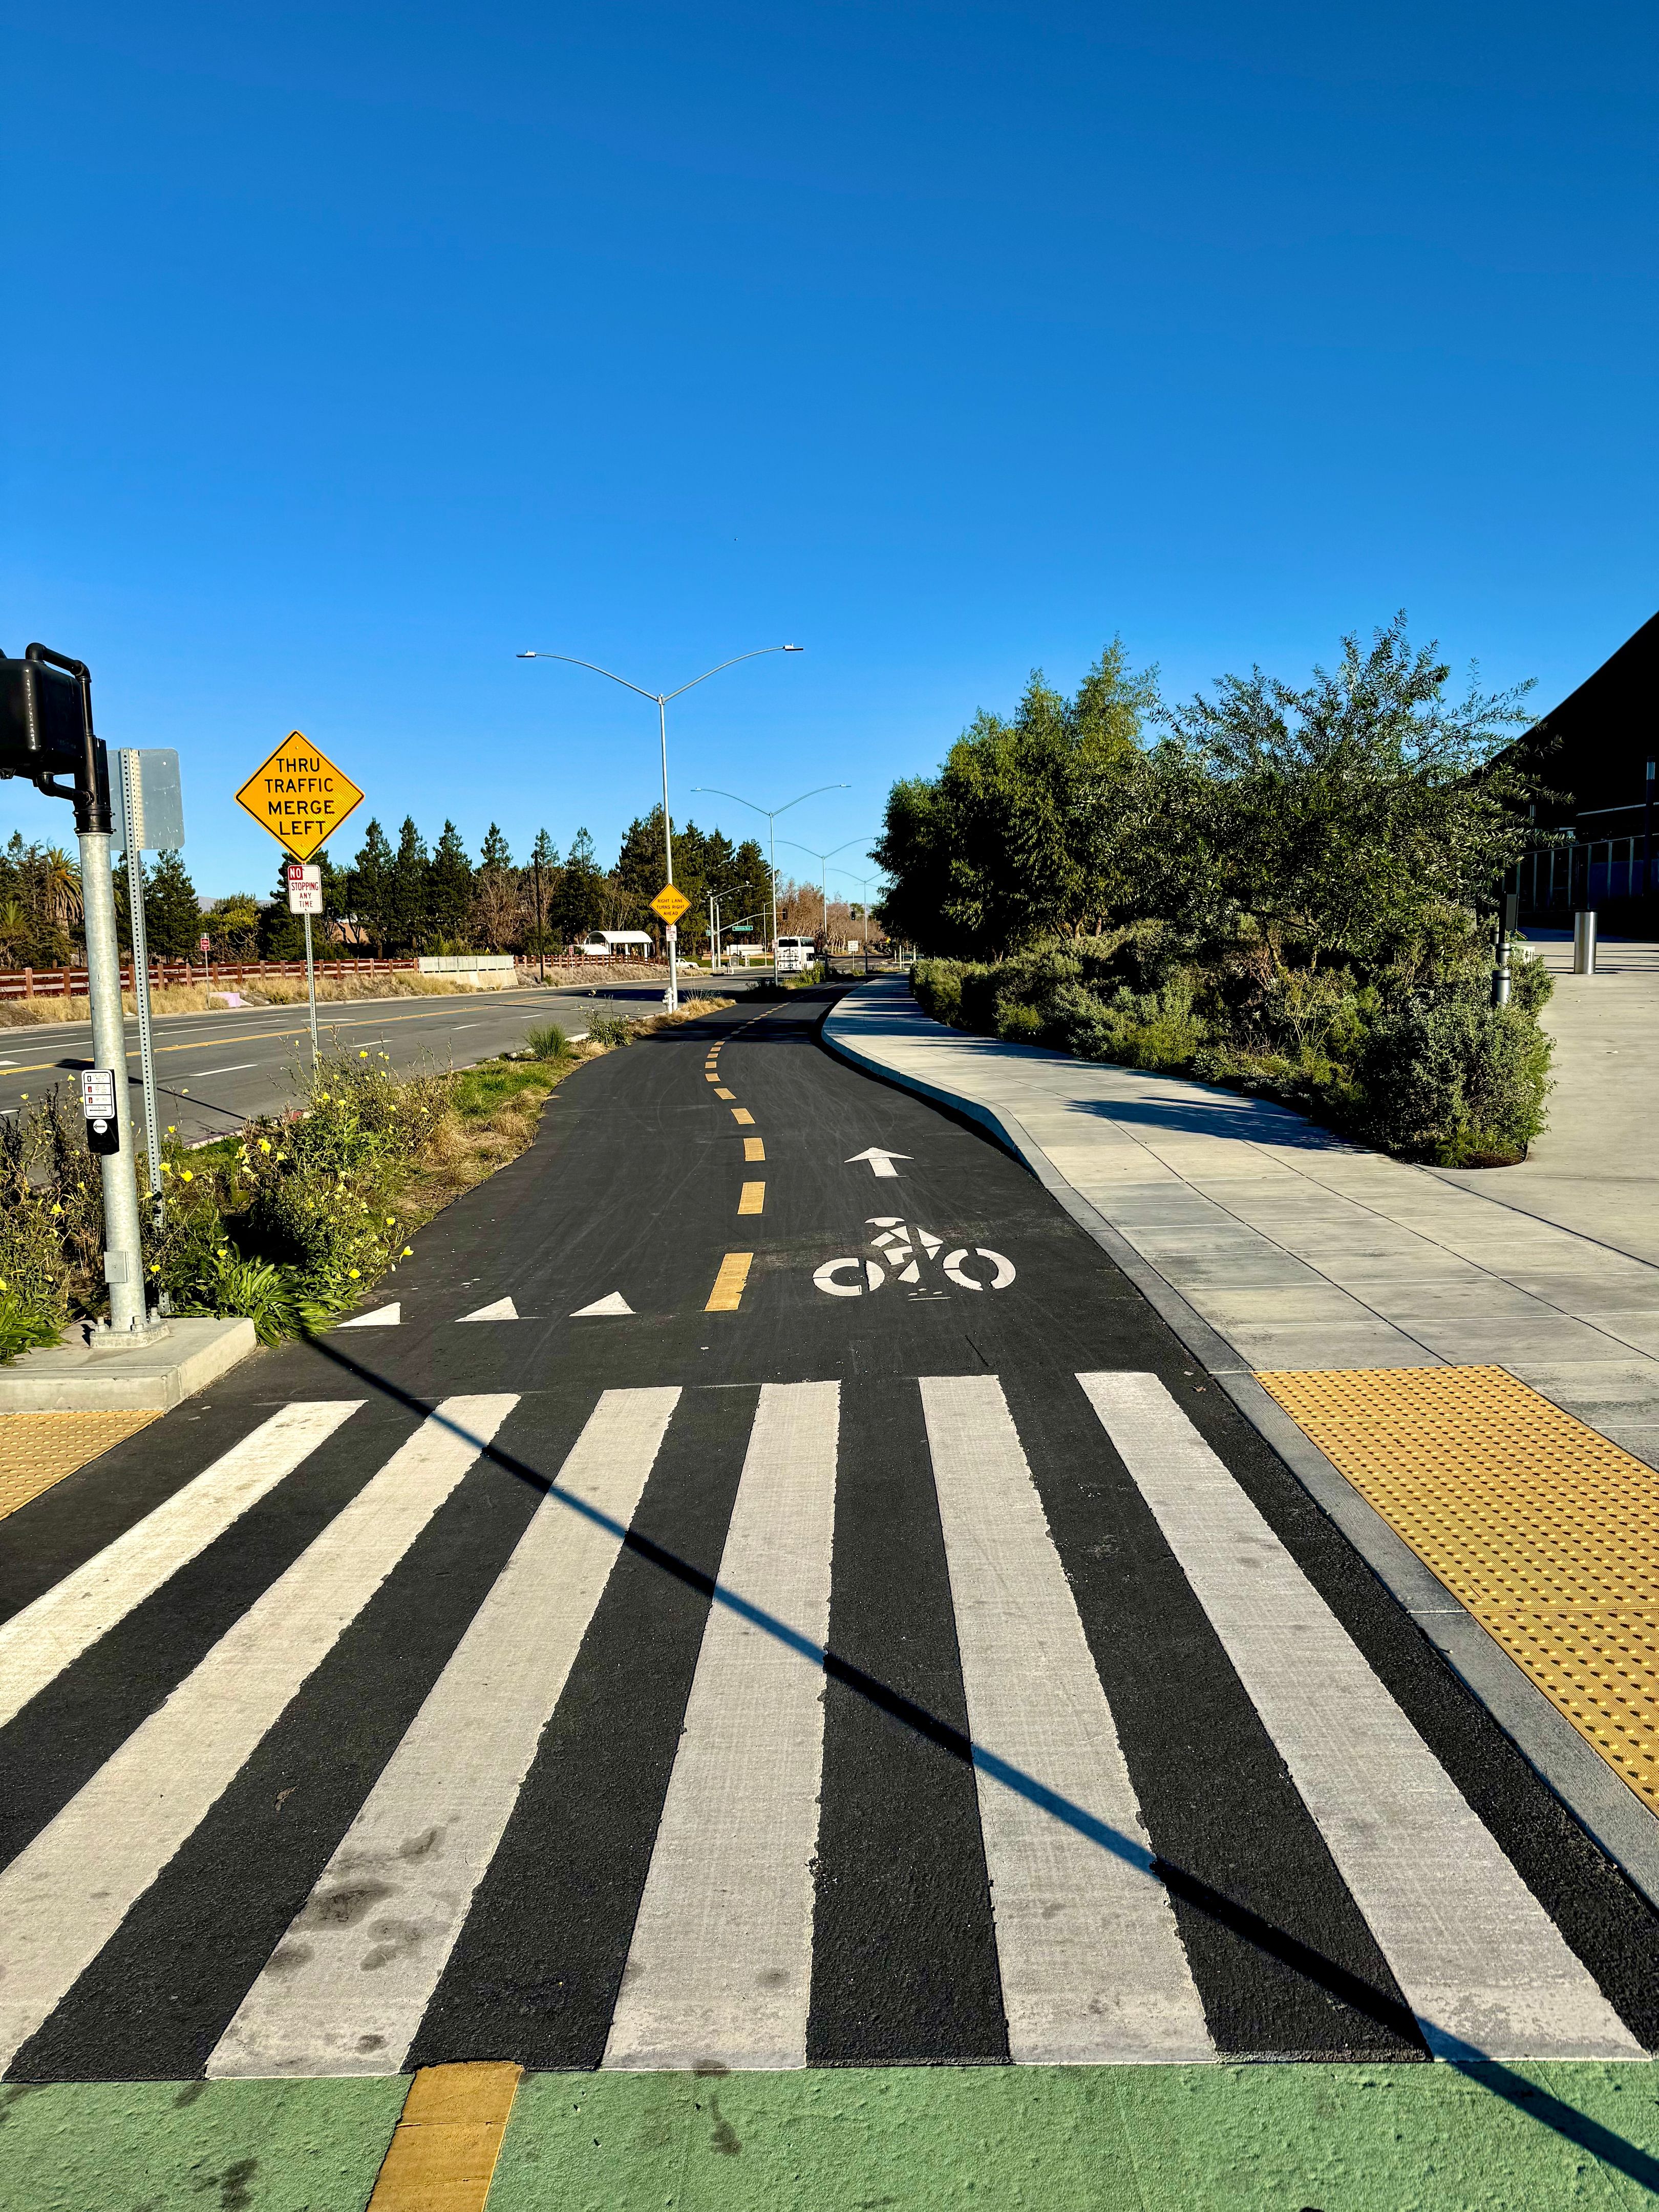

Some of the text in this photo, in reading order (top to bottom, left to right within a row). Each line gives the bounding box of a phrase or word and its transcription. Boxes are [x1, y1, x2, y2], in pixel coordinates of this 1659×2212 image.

[276, 757, 320, 773] THRU
[264, 777, 333, 793] TRAFFIC
[268, 800, 335, 815] MERGE
[279, 820, 326, 836] LEFT
[290, 867, 302, 878] NO
[291, 882, 318, 891] STOPPING
